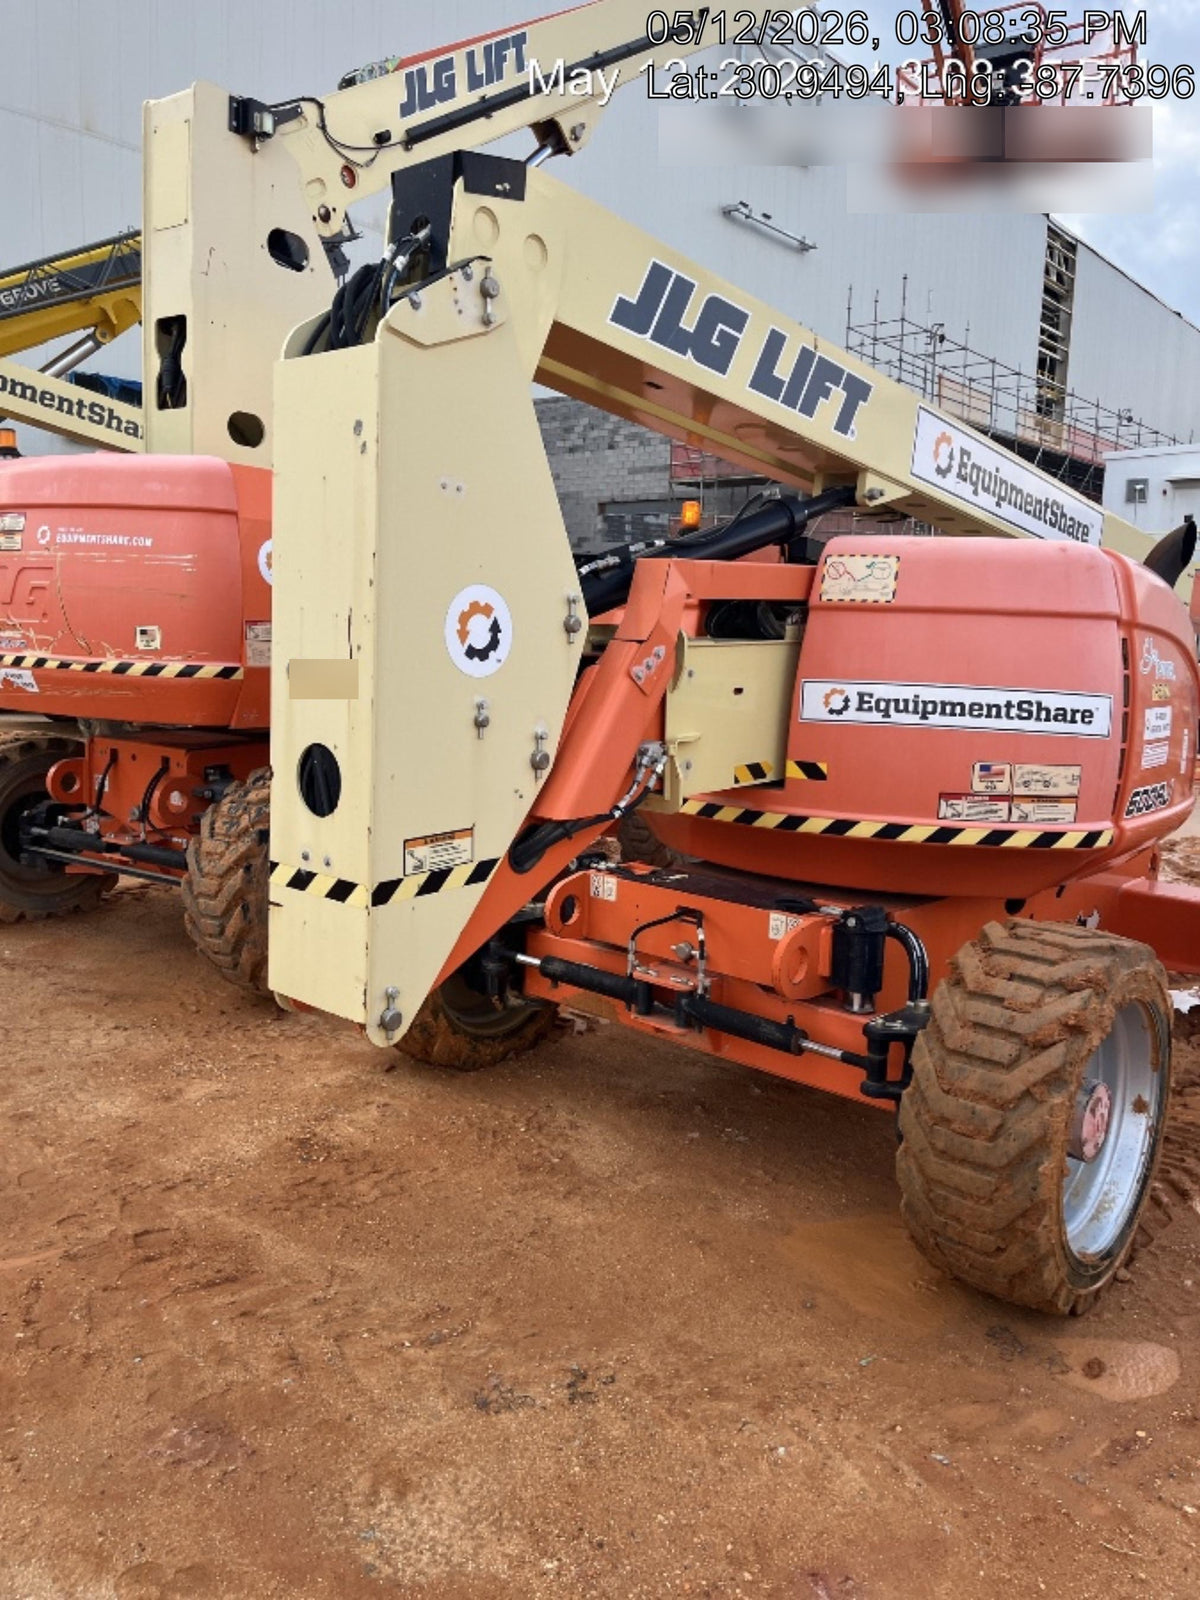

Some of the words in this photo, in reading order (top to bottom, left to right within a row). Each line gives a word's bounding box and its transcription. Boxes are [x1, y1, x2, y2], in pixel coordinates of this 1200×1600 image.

[400, 56, 457, 119] JLG
[465, 30, 528, 93] LIFT
[608, 257, 752, 379] JLG
[746, 325, 875, 440] LIFT
[0, 374, 144, 440] mentSha
[955, 446, 1091, 543] EquipmentShare
[855, 690, 1095, 725] EquipmentShare
